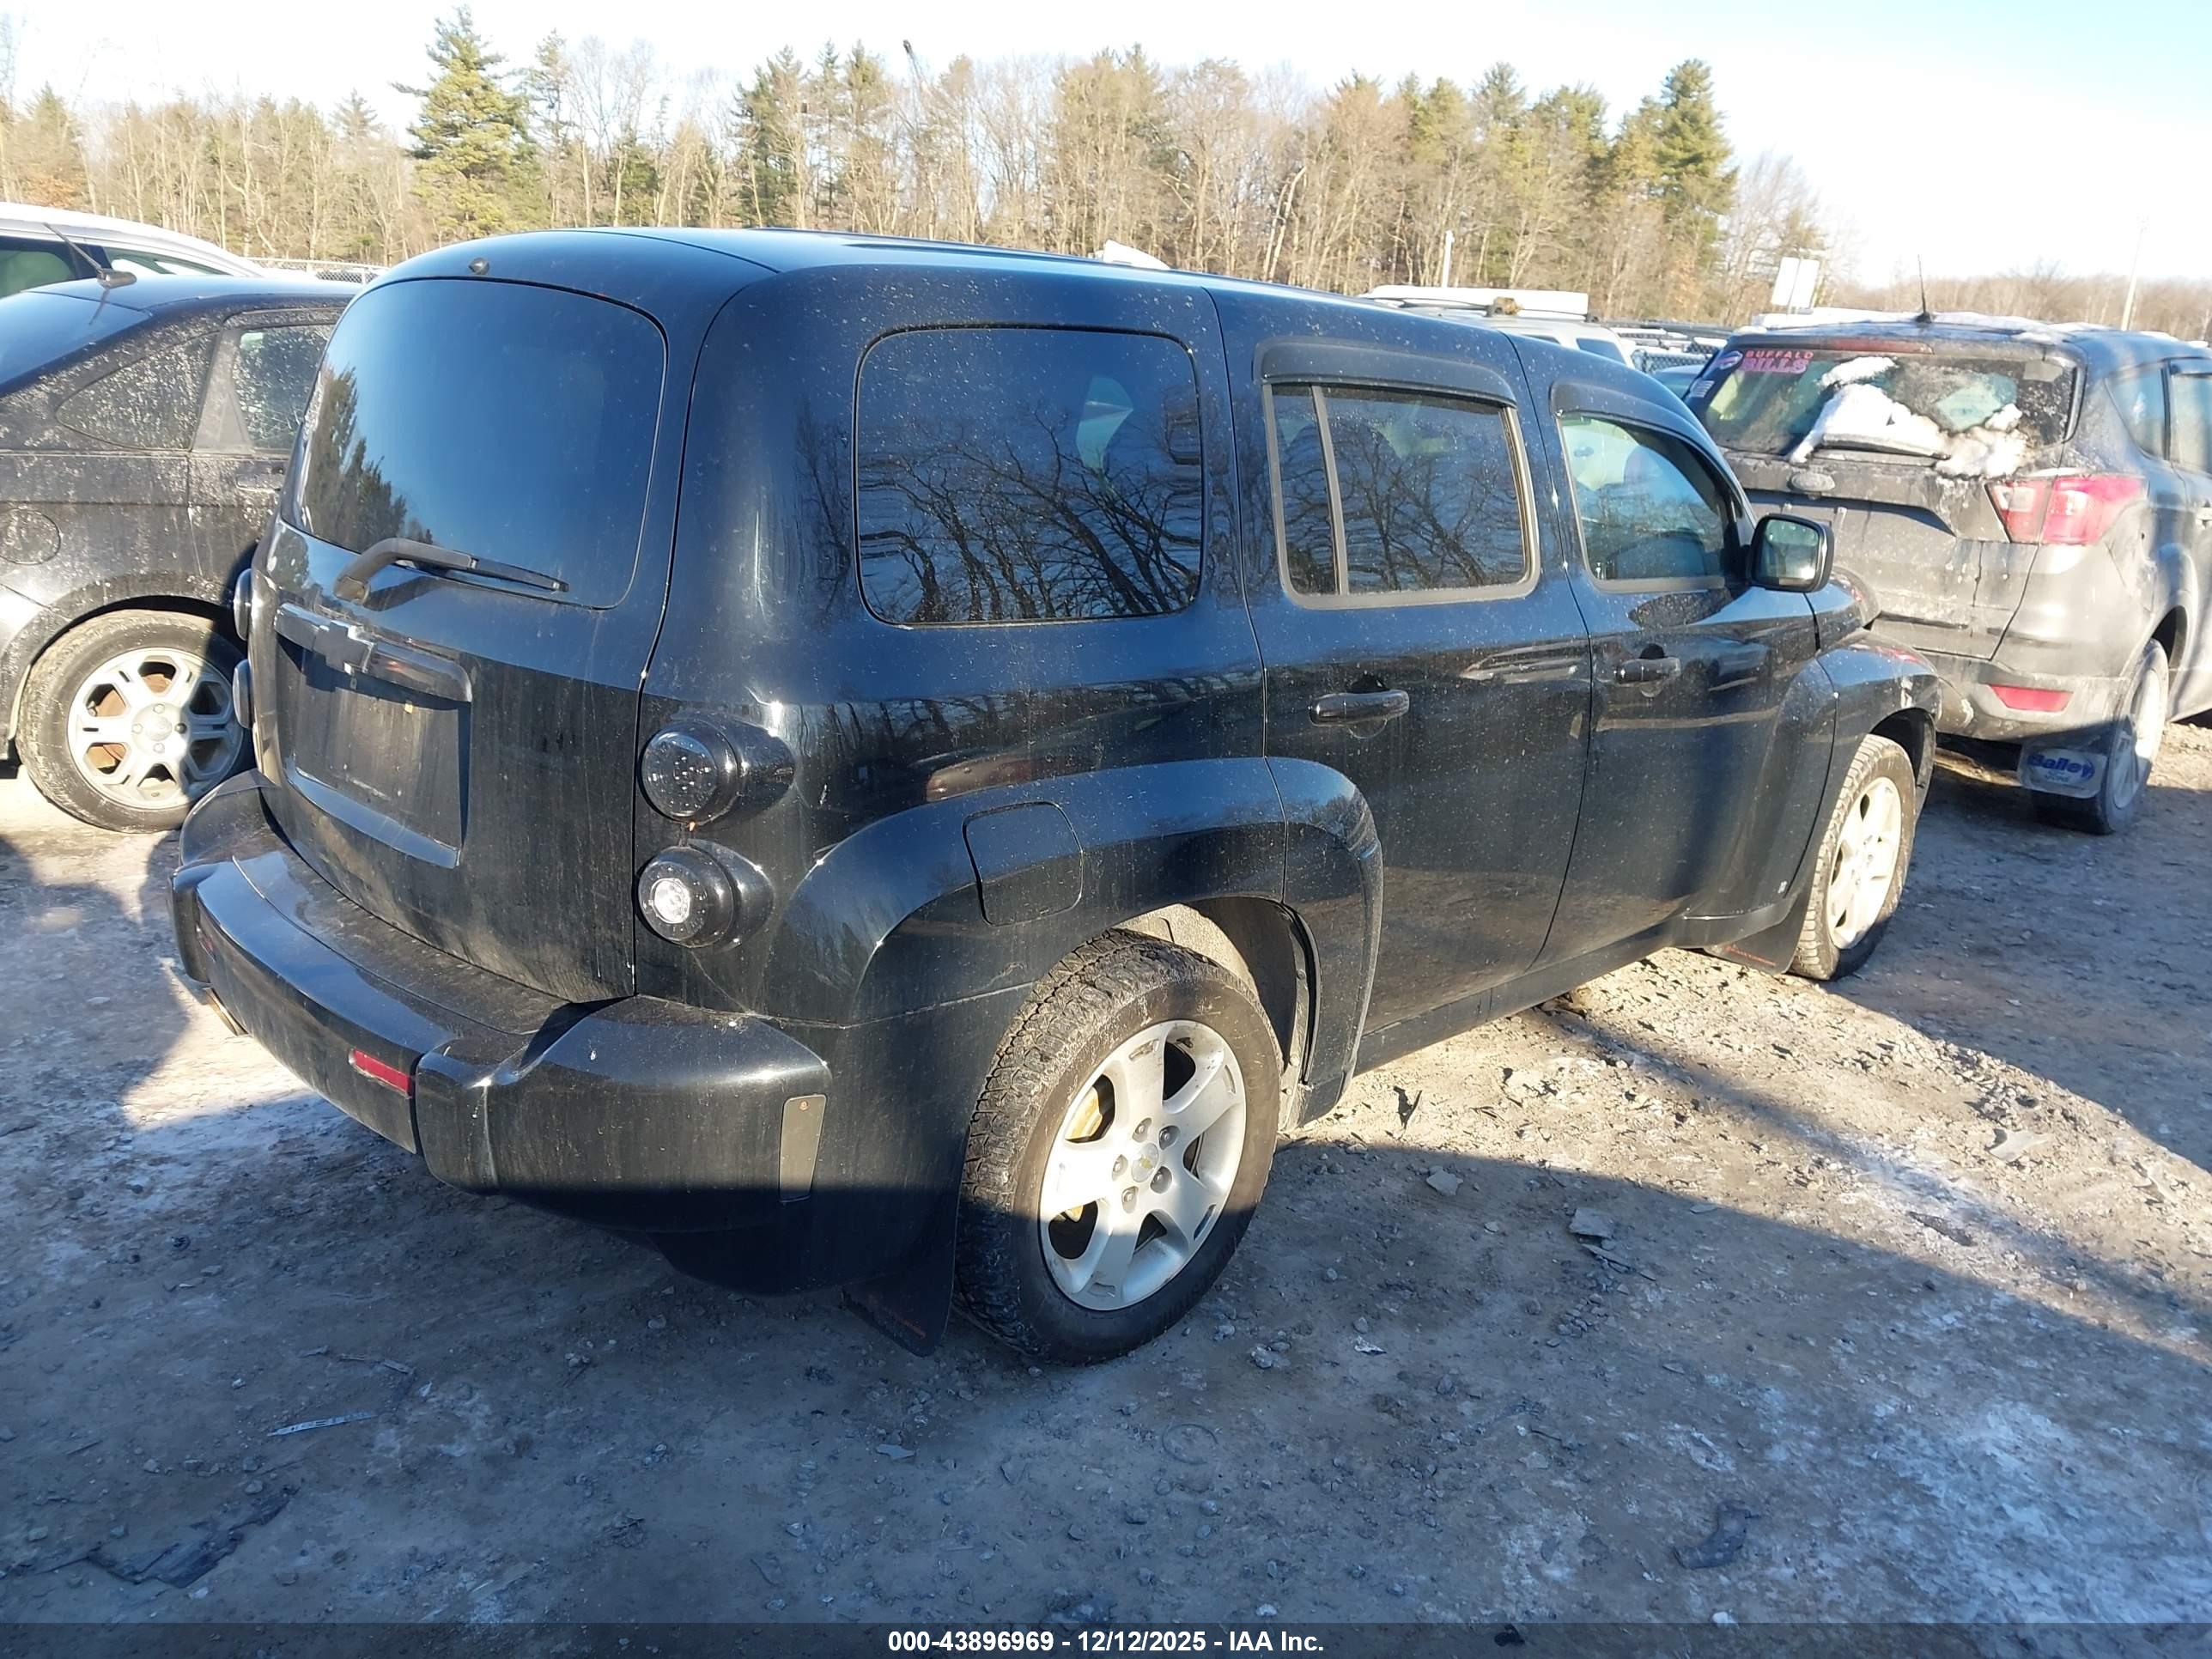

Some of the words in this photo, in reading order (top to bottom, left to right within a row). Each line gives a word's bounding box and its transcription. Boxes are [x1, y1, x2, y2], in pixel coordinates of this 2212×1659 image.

[1745, 350, 1814, 359] BUFFALO
[1738, 358, 1808, 373] BILLS
[2027, 755, 2094, 778] Bailey
